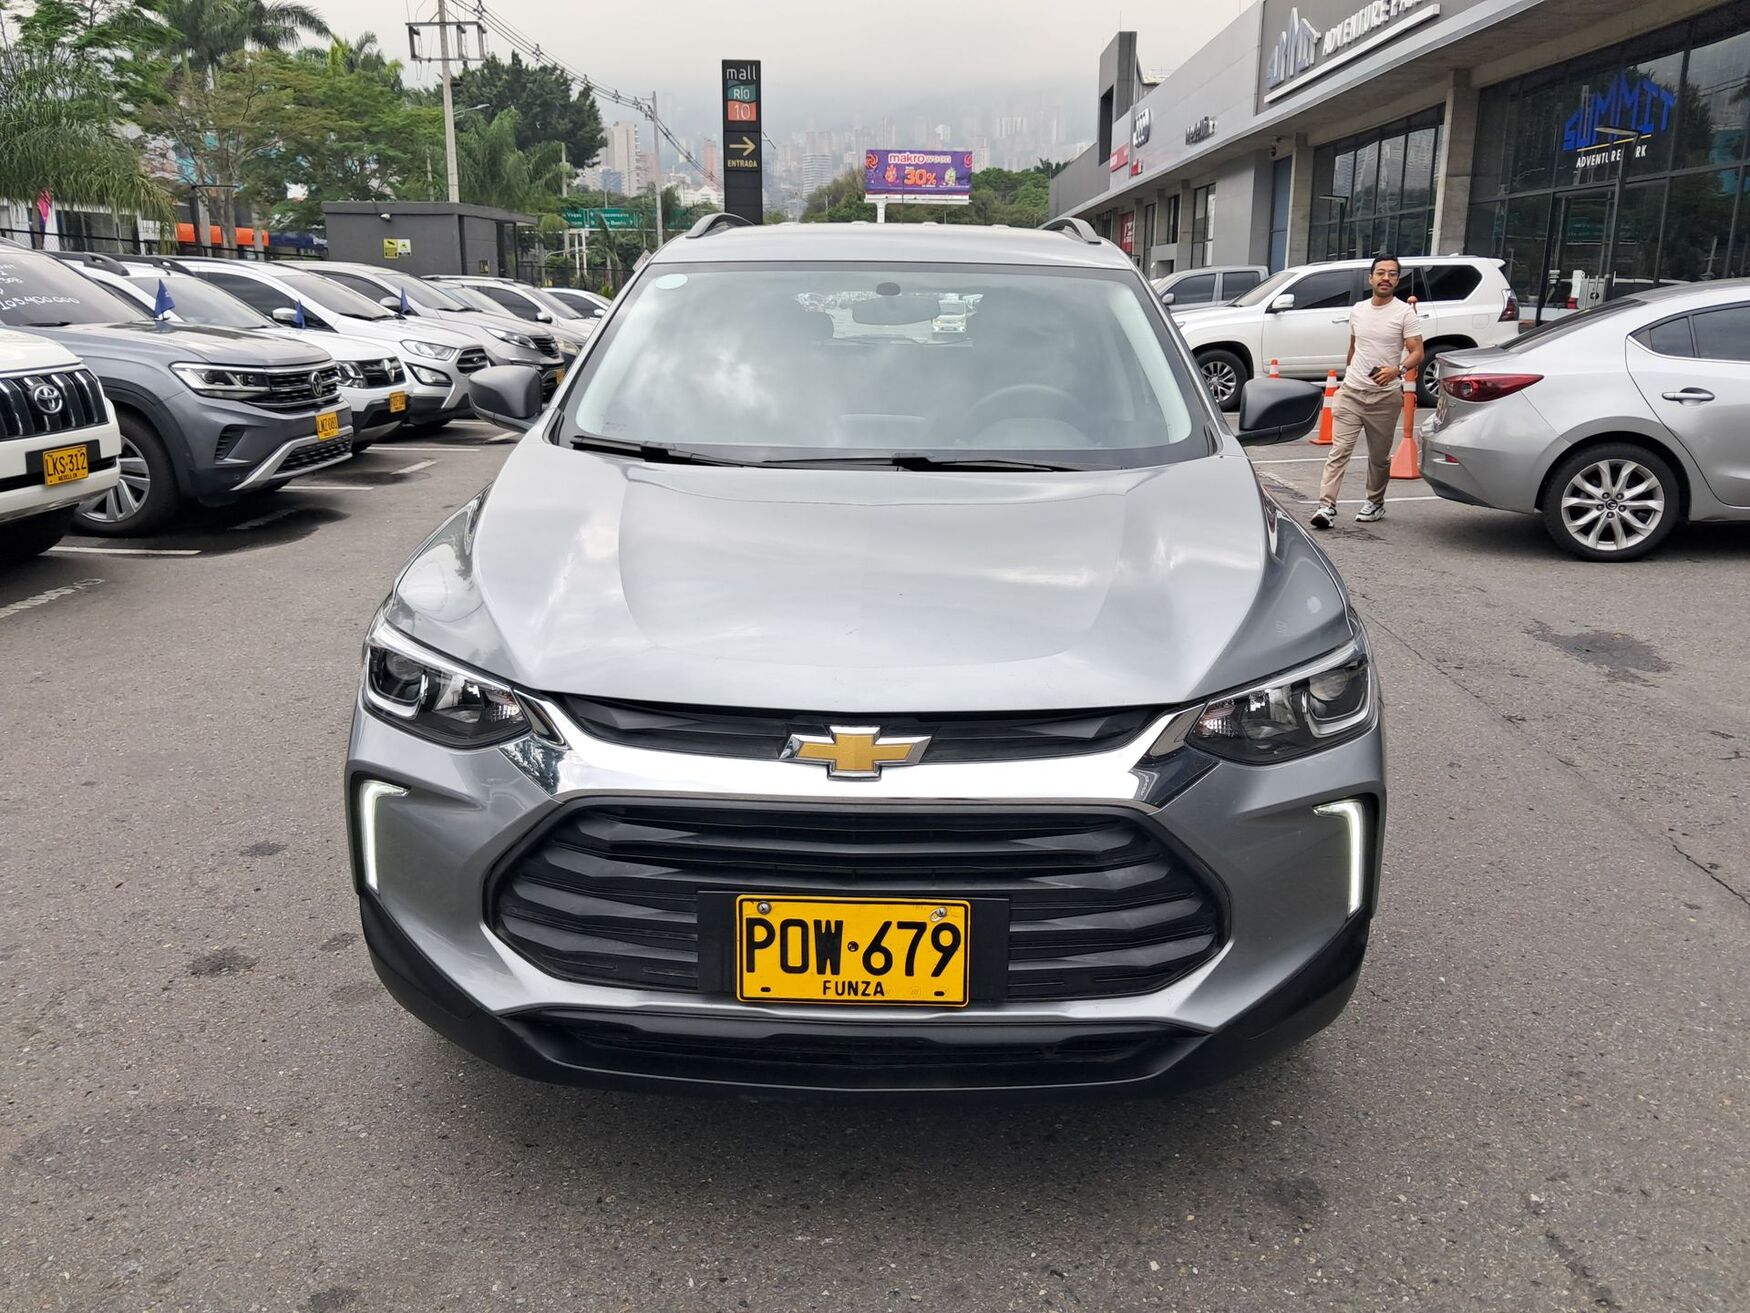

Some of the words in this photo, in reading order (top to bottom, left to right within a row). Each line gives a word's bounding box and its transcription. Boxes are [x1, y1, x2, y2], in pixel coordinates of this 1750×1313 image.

[1322, 0, 1389, 56] ADVENTURE
[726, 65, 757, 80] mall
[734, 104, 751, 120] 10
[1562, 72, 1678, 152] SUMMIT
[727, 160, 758, 168] ENTRADA
[904, 169, 937, 187] 30%
[822, 980, 885, 997] FUNZA
